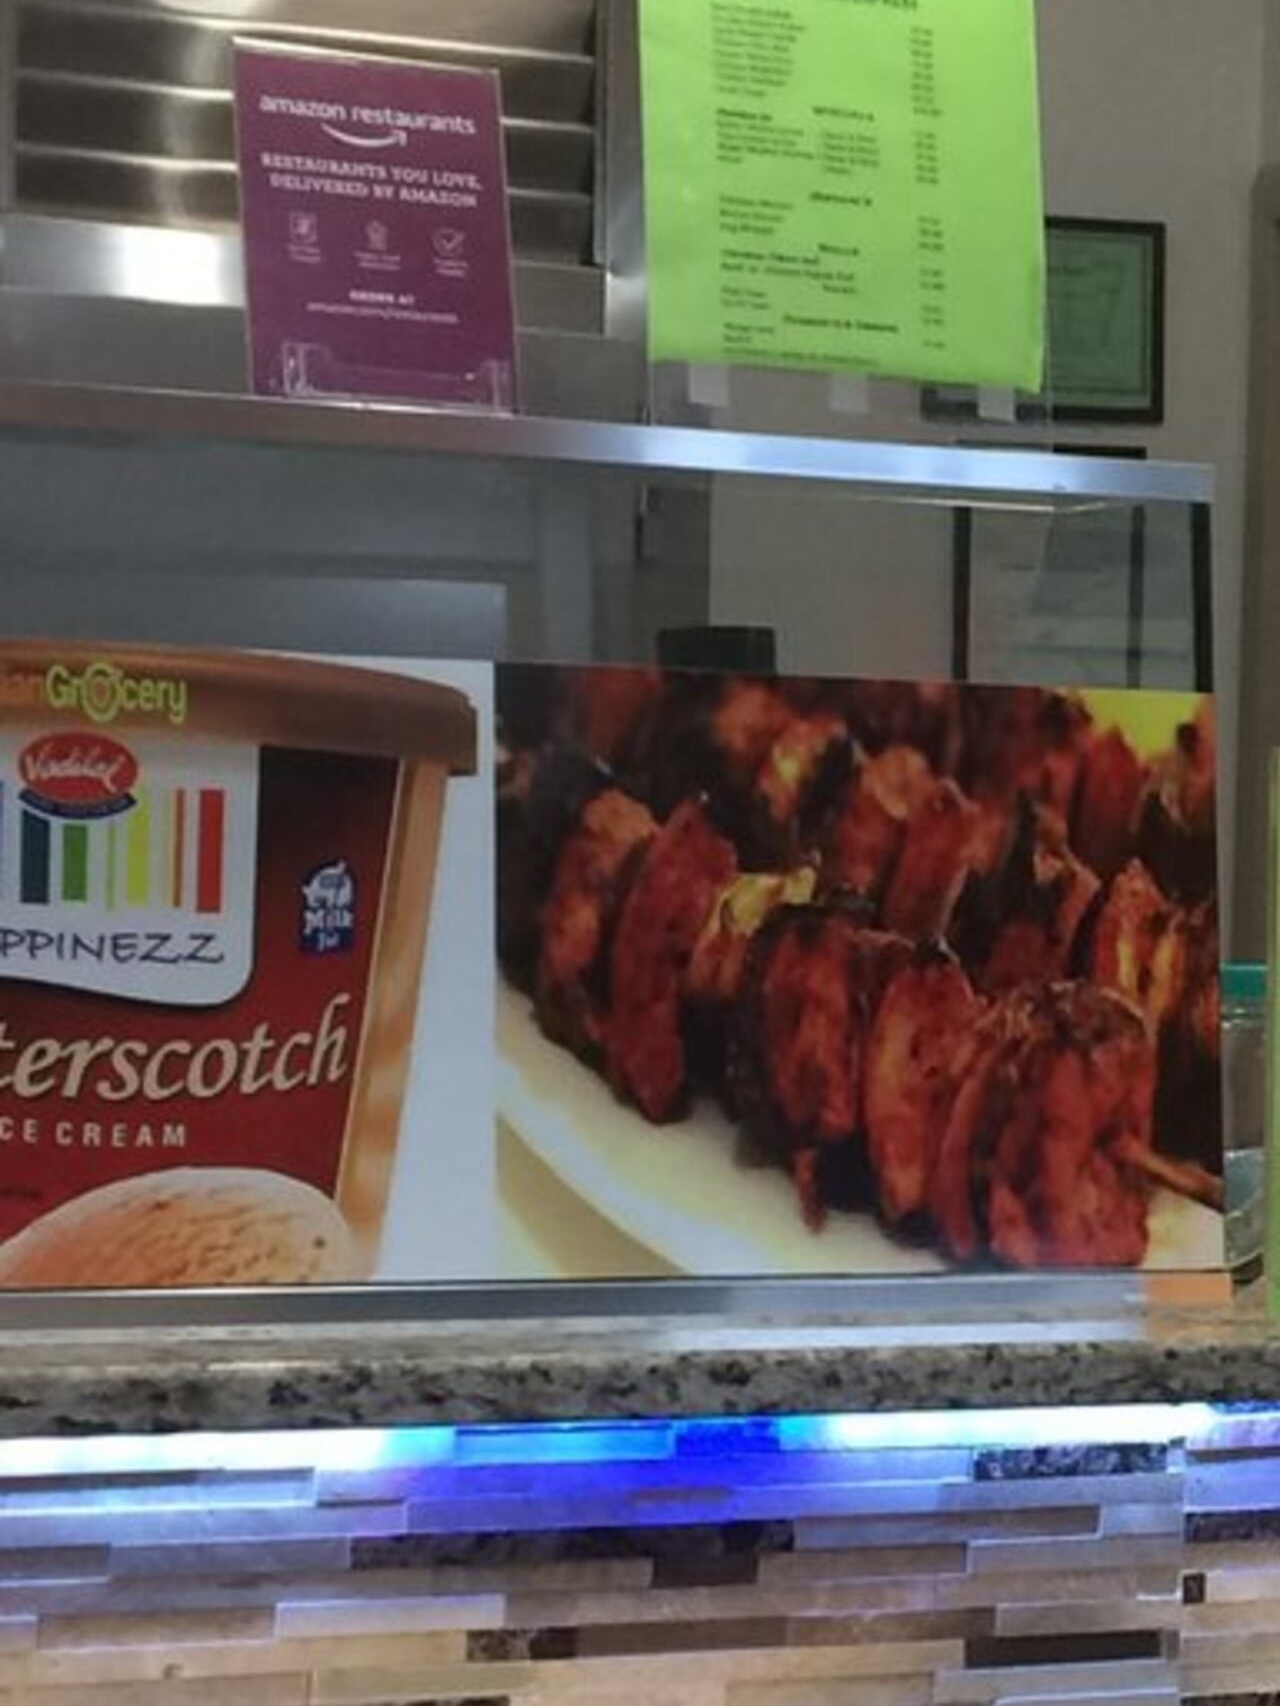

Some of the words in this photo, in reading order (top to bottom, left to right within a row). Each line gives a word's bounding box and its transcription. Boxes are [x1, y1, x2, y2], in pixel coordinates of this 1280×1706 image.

[259, 96, 347, 120] amazon
[351, 107, 477, 135] restaurants
[260, 152, 388, 181] RESTAURANTS
[392, 167, 428, 184] YOU
[433, 170, 482, 191] LOVE,
[269, 173, 368, 197] DELIVERED
[372, 185, 395, 198] BY
[399, 187, 478, 208] AMAZON
[55, 1121, 187, 1148] CREAM
